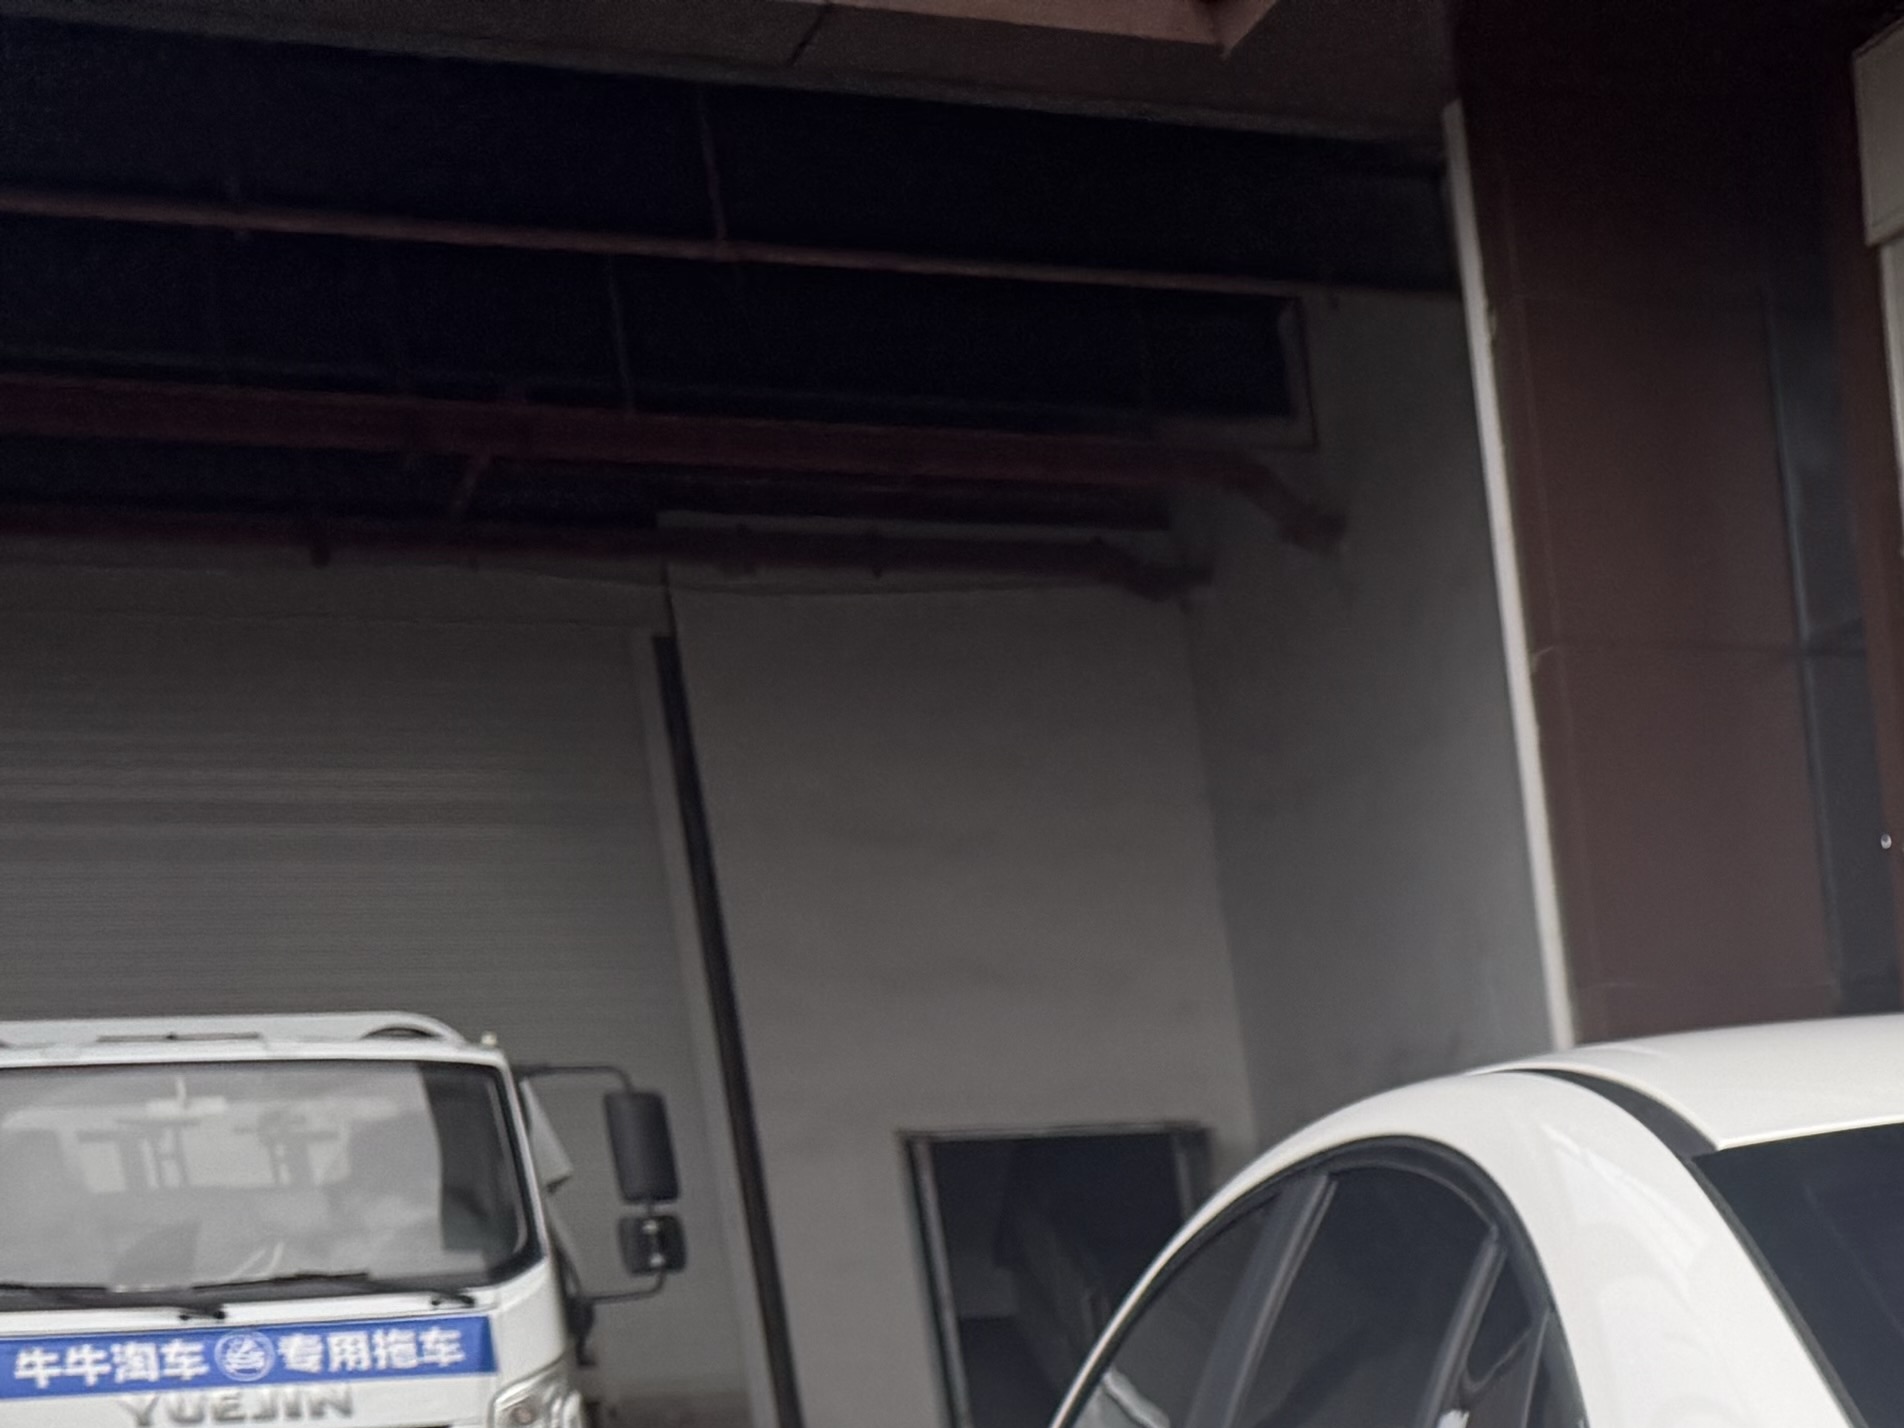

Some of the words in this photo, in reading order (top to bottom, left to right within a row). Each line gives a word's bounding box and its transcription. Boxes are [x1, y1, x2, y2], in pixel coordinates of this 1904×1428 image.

[14, 1340, 209, 1389] 牛牛淘车
[278, 1327, 466, 1374] 专用拖车
